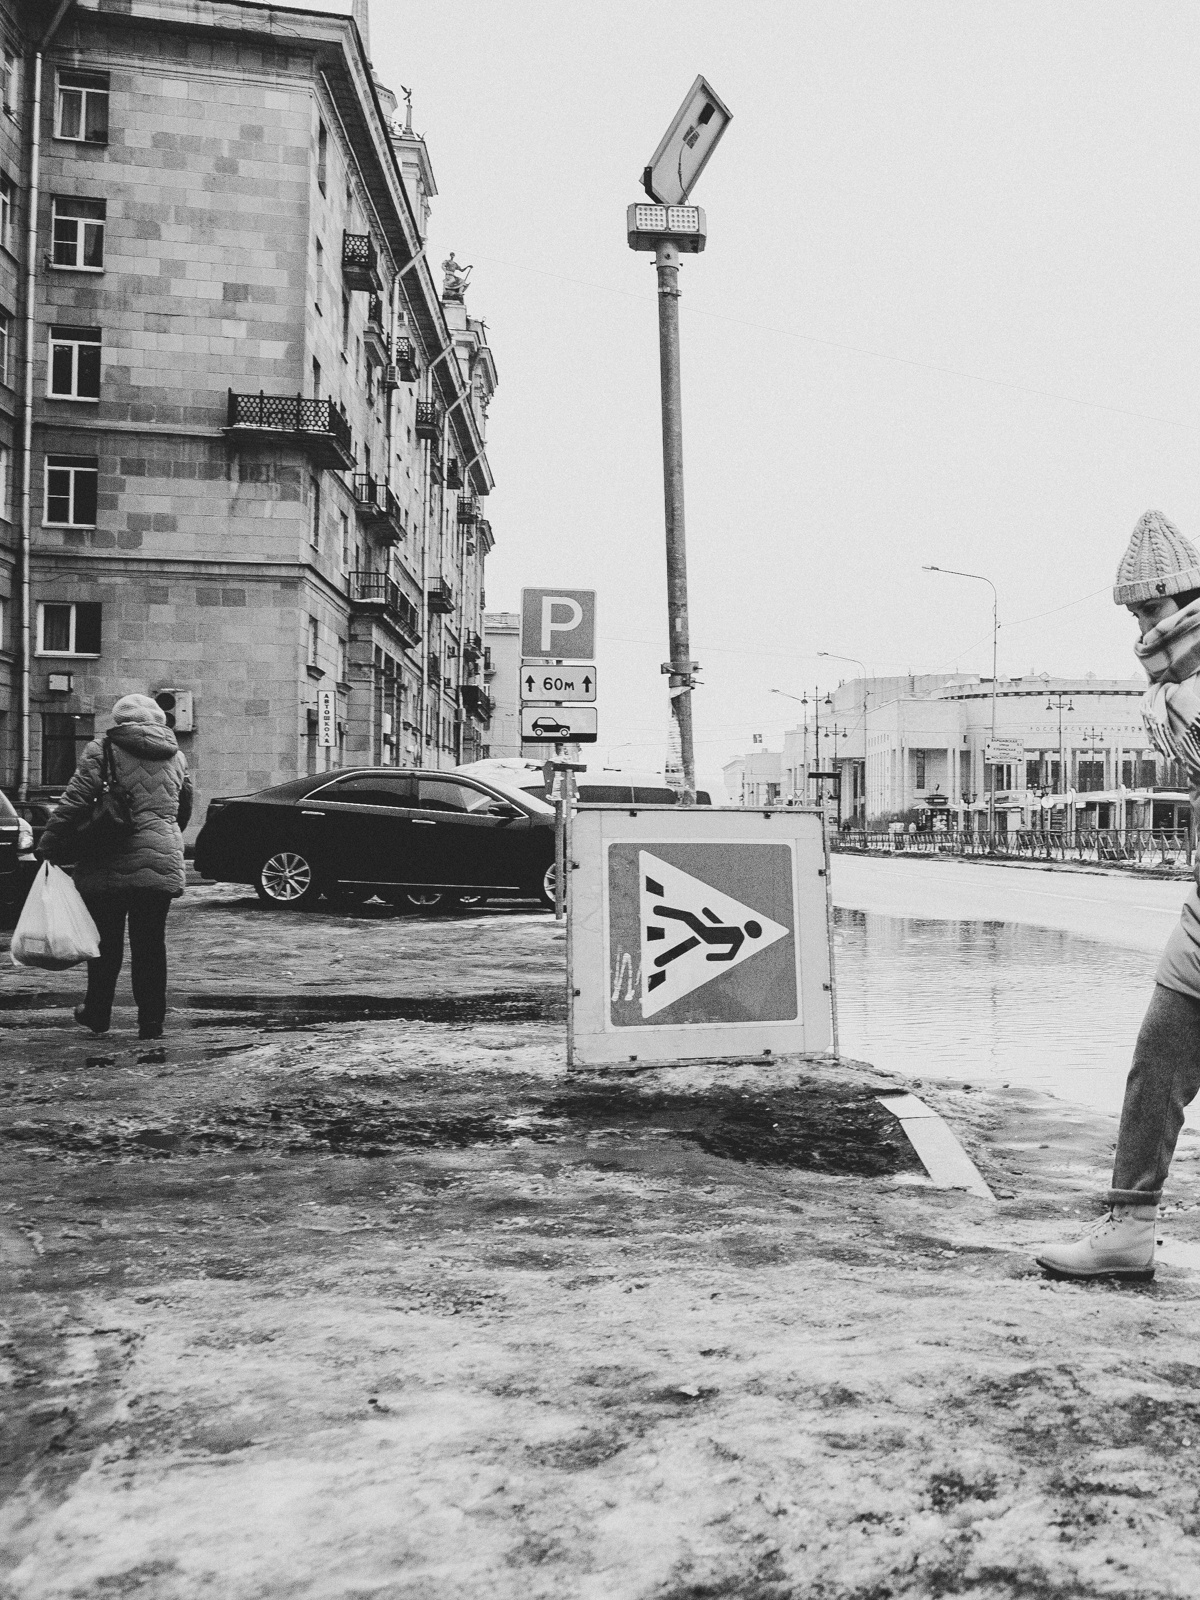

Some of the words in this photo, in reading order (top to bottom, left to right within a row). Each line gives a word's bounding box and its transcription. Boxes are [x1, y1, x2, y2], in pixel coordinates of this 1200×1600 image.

[541, 596, 583, 651] P
[543, 677, 575, 691] 60м
[323, 693, 331, 744] АВТОШКОЛА
